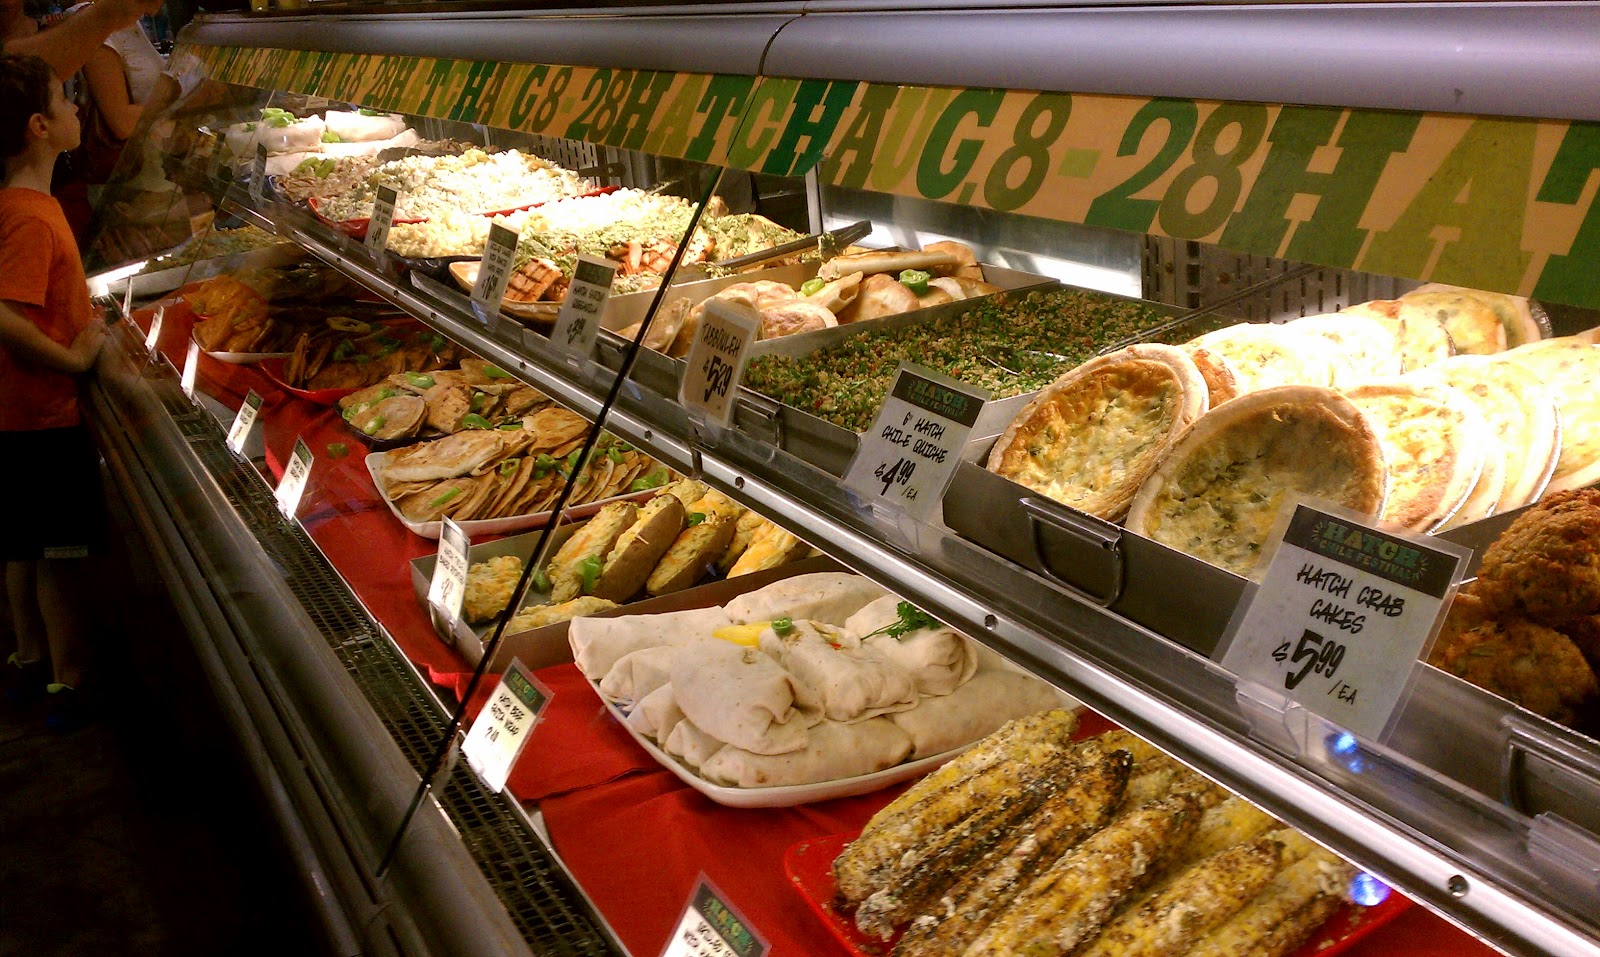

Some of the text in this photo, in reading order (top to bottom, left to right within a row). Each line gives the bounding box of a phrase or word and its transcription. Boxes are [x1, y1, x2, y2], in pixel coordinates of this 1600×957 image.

[379, 57, 500, 123] HATCH
[606, 69, 861, 176] HATCH
[881, 425, 949, 464] CHILE QUICHE
[914, 417, 946, 441] HATCH
[1322, 520, 1420, 571] HATCH
[1296, 563, 1406, 618] HATCH CRAB
[1309, 599, 1367, 635] CAKES
